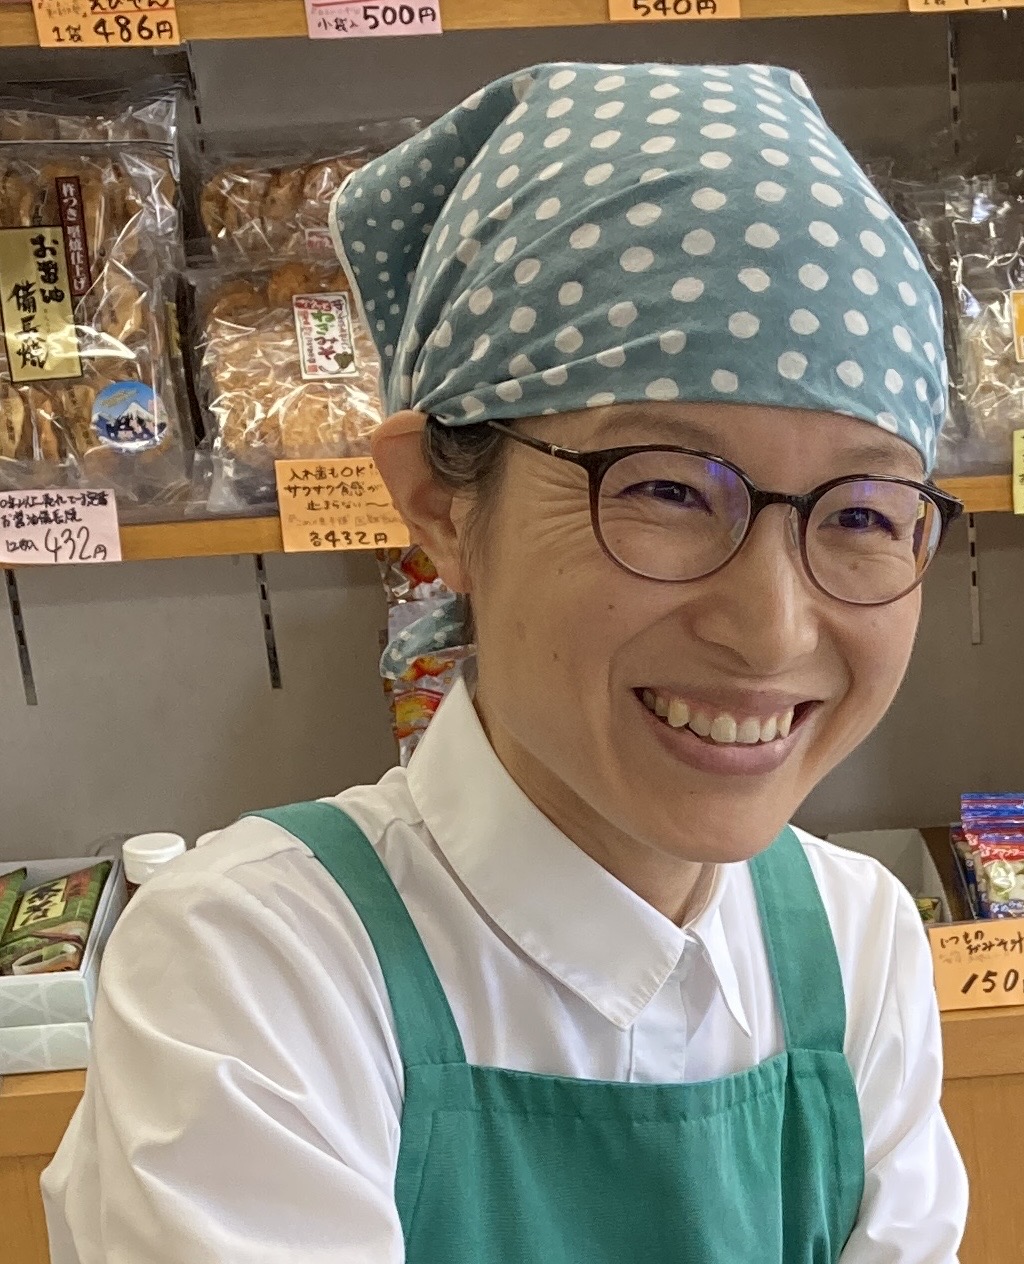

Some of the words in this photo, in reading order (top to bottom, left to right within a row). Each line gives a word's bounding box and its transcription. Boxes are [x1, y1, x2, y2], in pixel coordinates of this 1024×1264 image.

[93, 15, 173, 42] 486円
[363, 5, 436, 29] 500円
[44, 526, 108, 562] 432円
